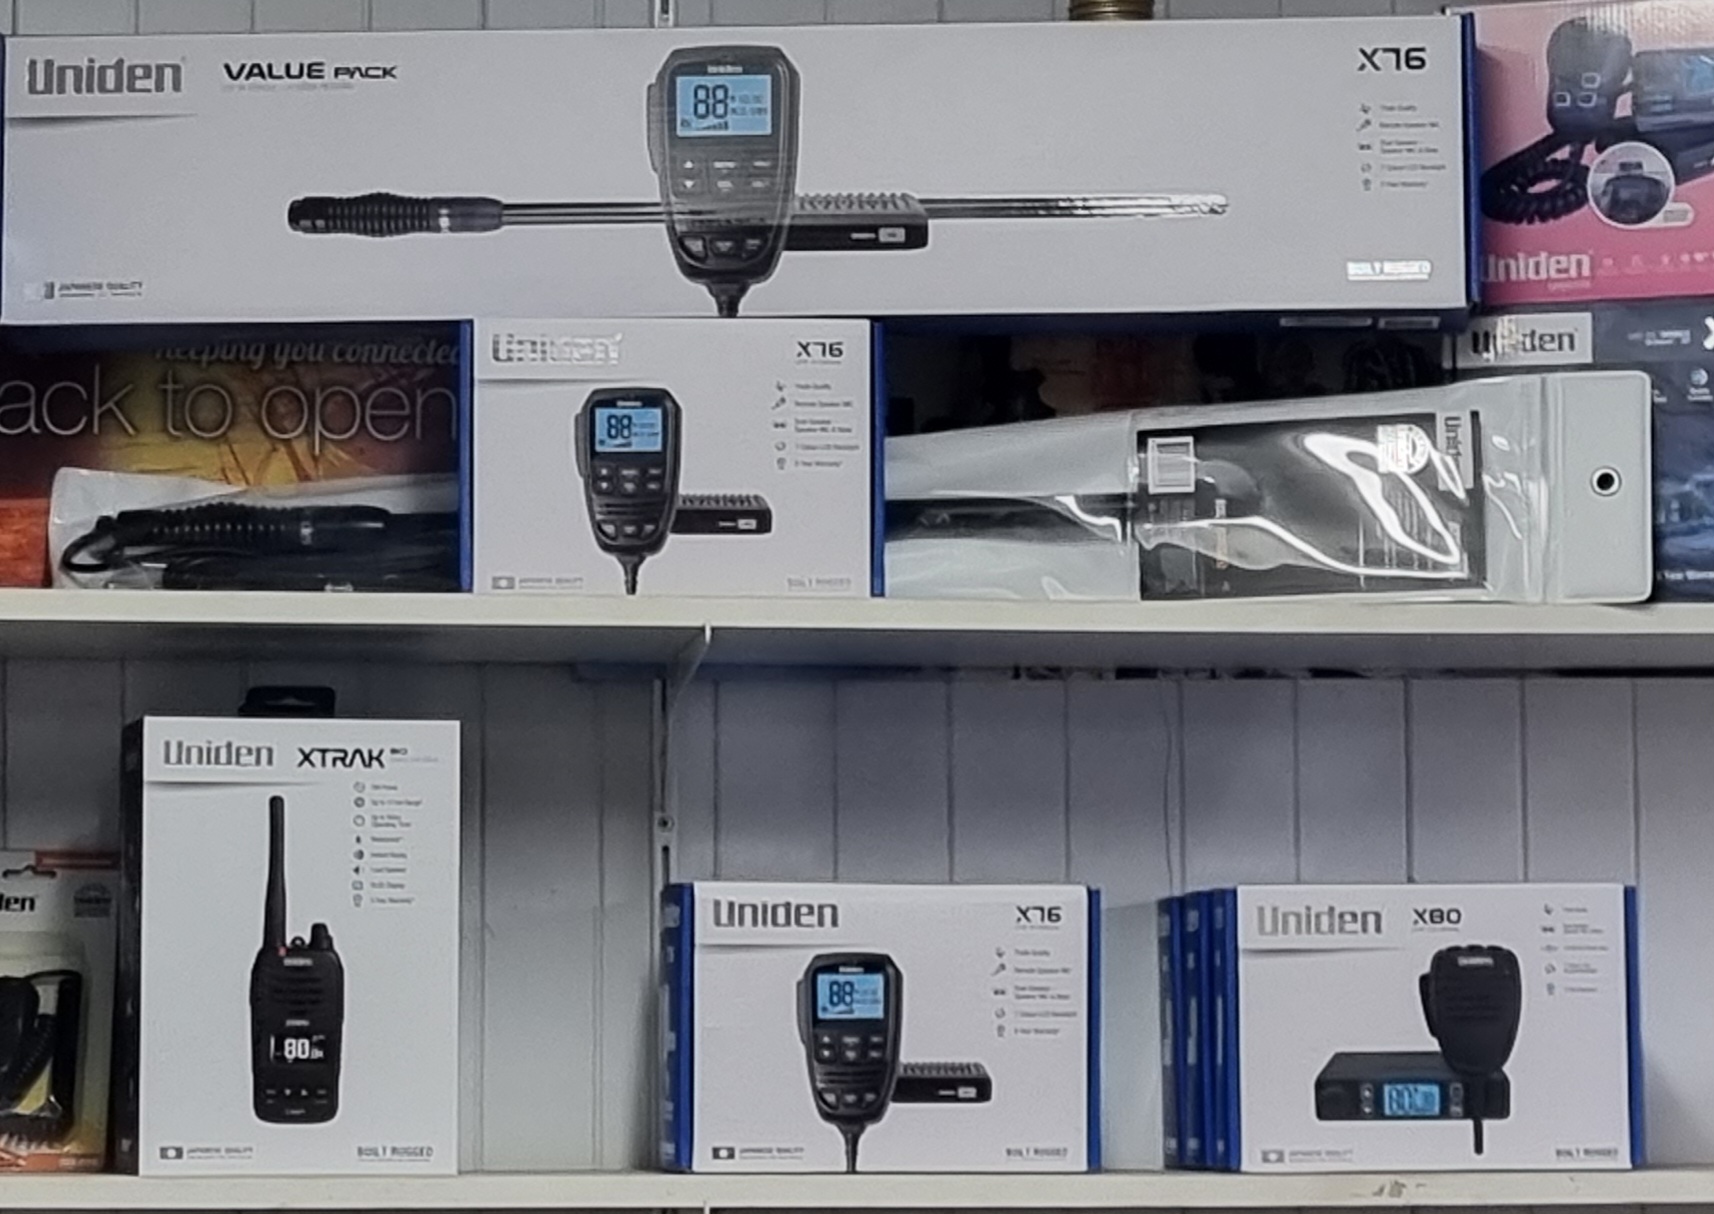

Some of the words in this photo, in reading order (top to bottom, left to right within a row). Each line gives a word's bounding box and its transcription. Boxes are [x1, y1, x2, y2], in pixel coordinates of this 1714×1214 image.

[223, 62, 326, 81] VALUE
[333, 65, 397, 79] PACK
[1357, 47, 1427, 71] X76
[28, 57, 182, 95] Uniden
[693, 84, 729, 119] 88
[272, 341, 326, 370] you
[797, 341, 843, 358] X76
[160, 369, 232, 438] to
[261, 384, 458, 456] open
[607, 414, 632, 439] 88
[163, 740, 274, 767] Uniden
[297, 747, 385, 769] XTRAK
[713, 899, 839, 928] Uniden
[1016, 905, 1062, 923] X76
[1256, 905, 1382, 936] Uniden
[1412, 908, 1462, 925] X80
[829, 981, 854, 1007] 88
[283, 1037, 310, 1061] 80
